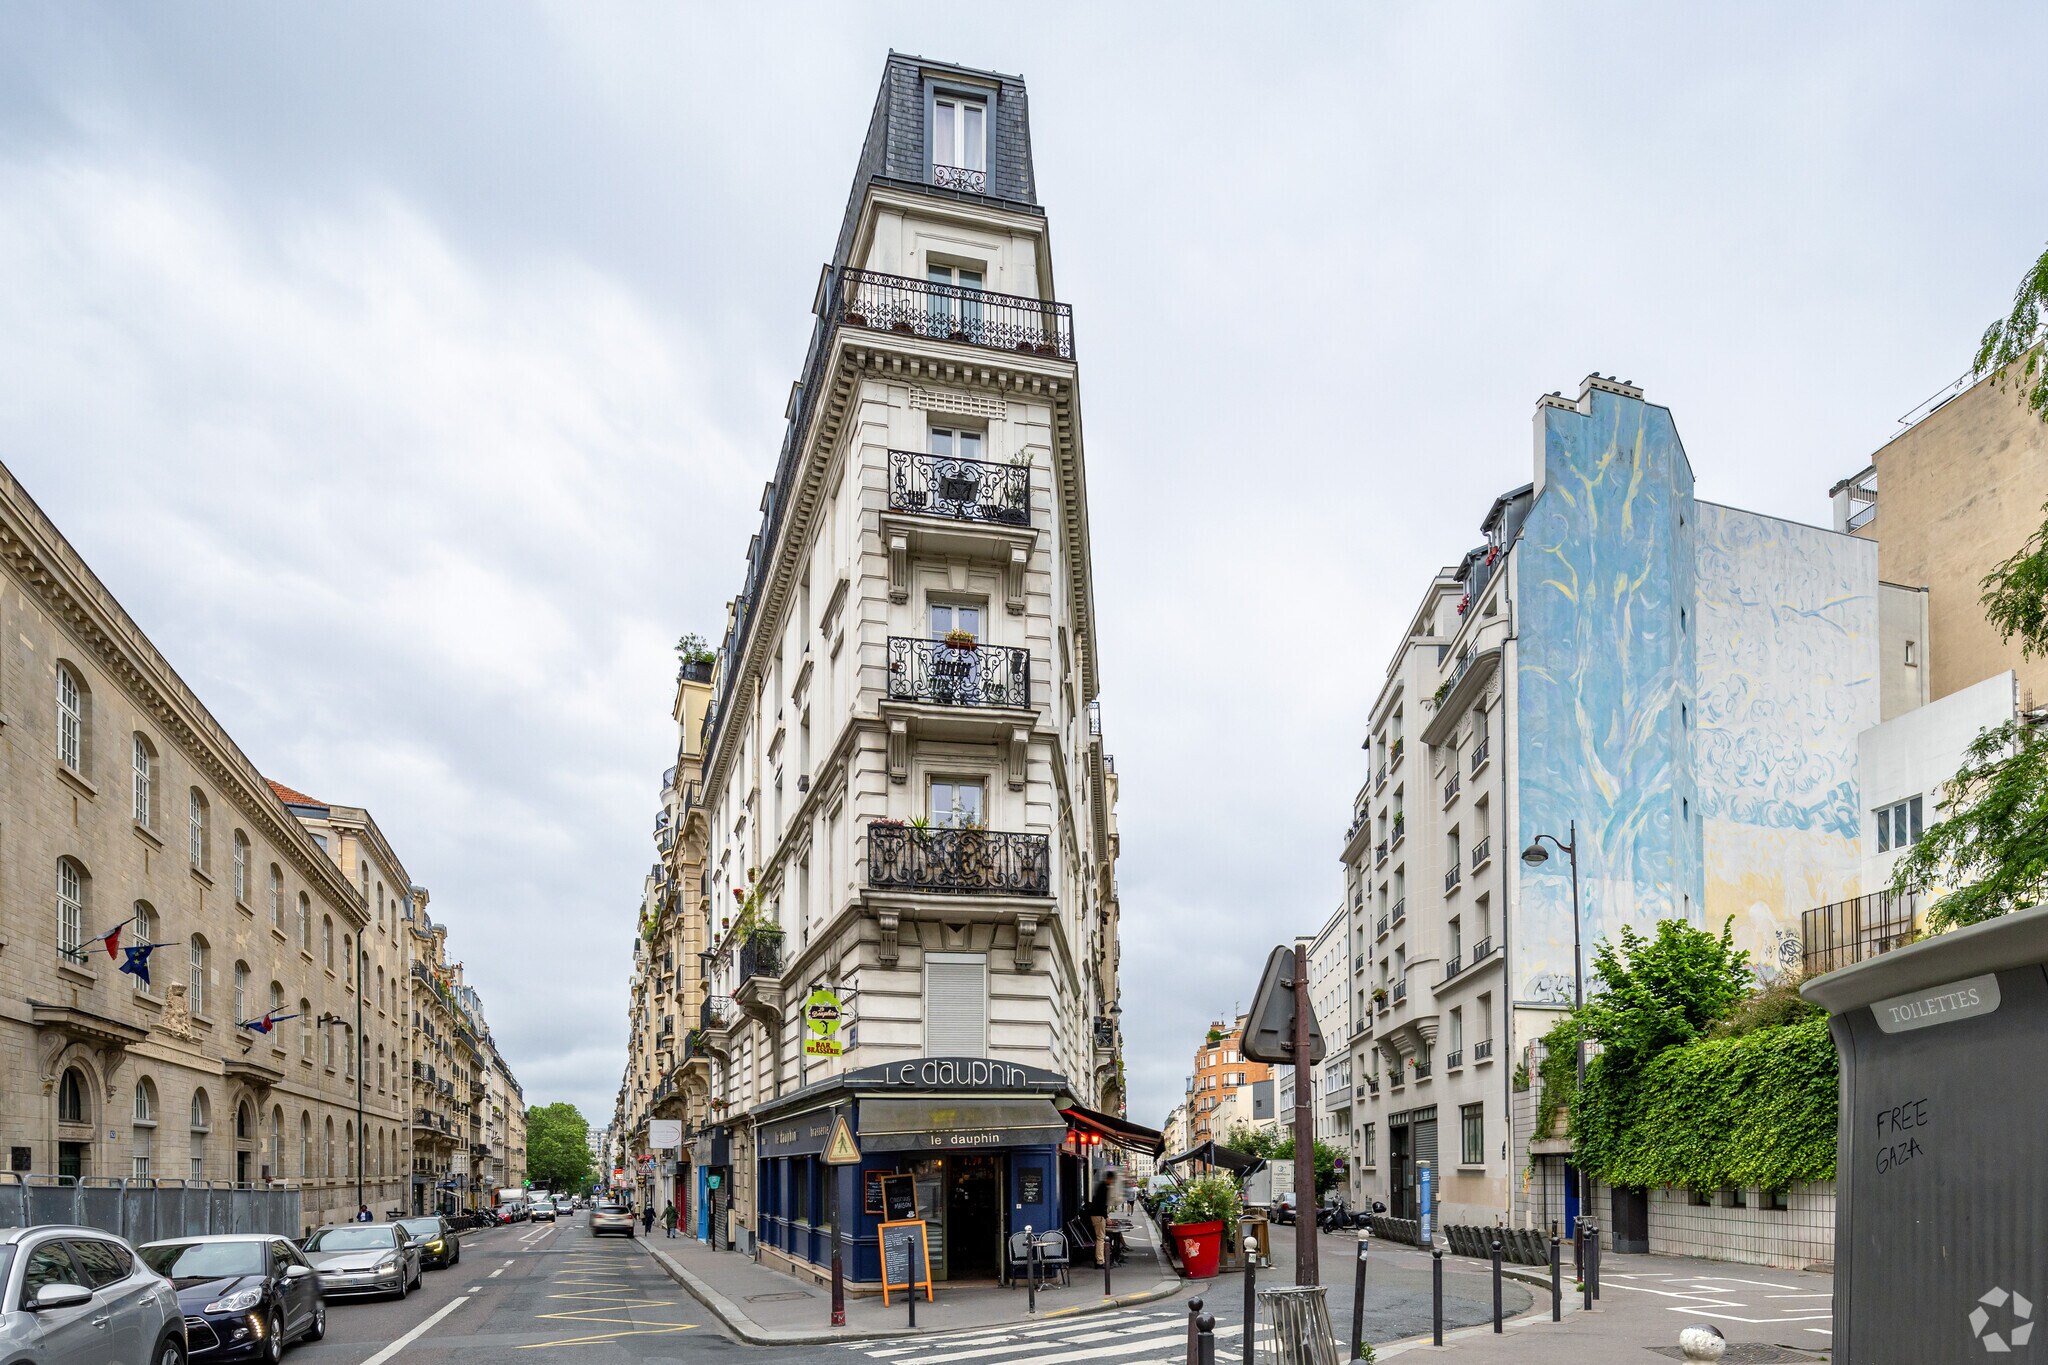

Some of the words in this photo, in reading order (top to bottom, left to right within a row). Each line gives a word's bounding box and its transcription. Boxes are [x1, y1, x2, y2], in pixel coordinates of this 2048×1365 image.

[1888, 988, 1980, 1023] TOILETTES
[807, 1046, 840, 1055] BRASSERIE
[886, 1064, 916, 1084] Le
[921, 1059, 1026, 1087] dauphin
[1876, 1098, 1928, 1140] FREE
[931, 1135, 942, 1145] le
[950, 1133, 1000, 1146] dauphin
[1876, 1137, 1924, 1175] GAZA
